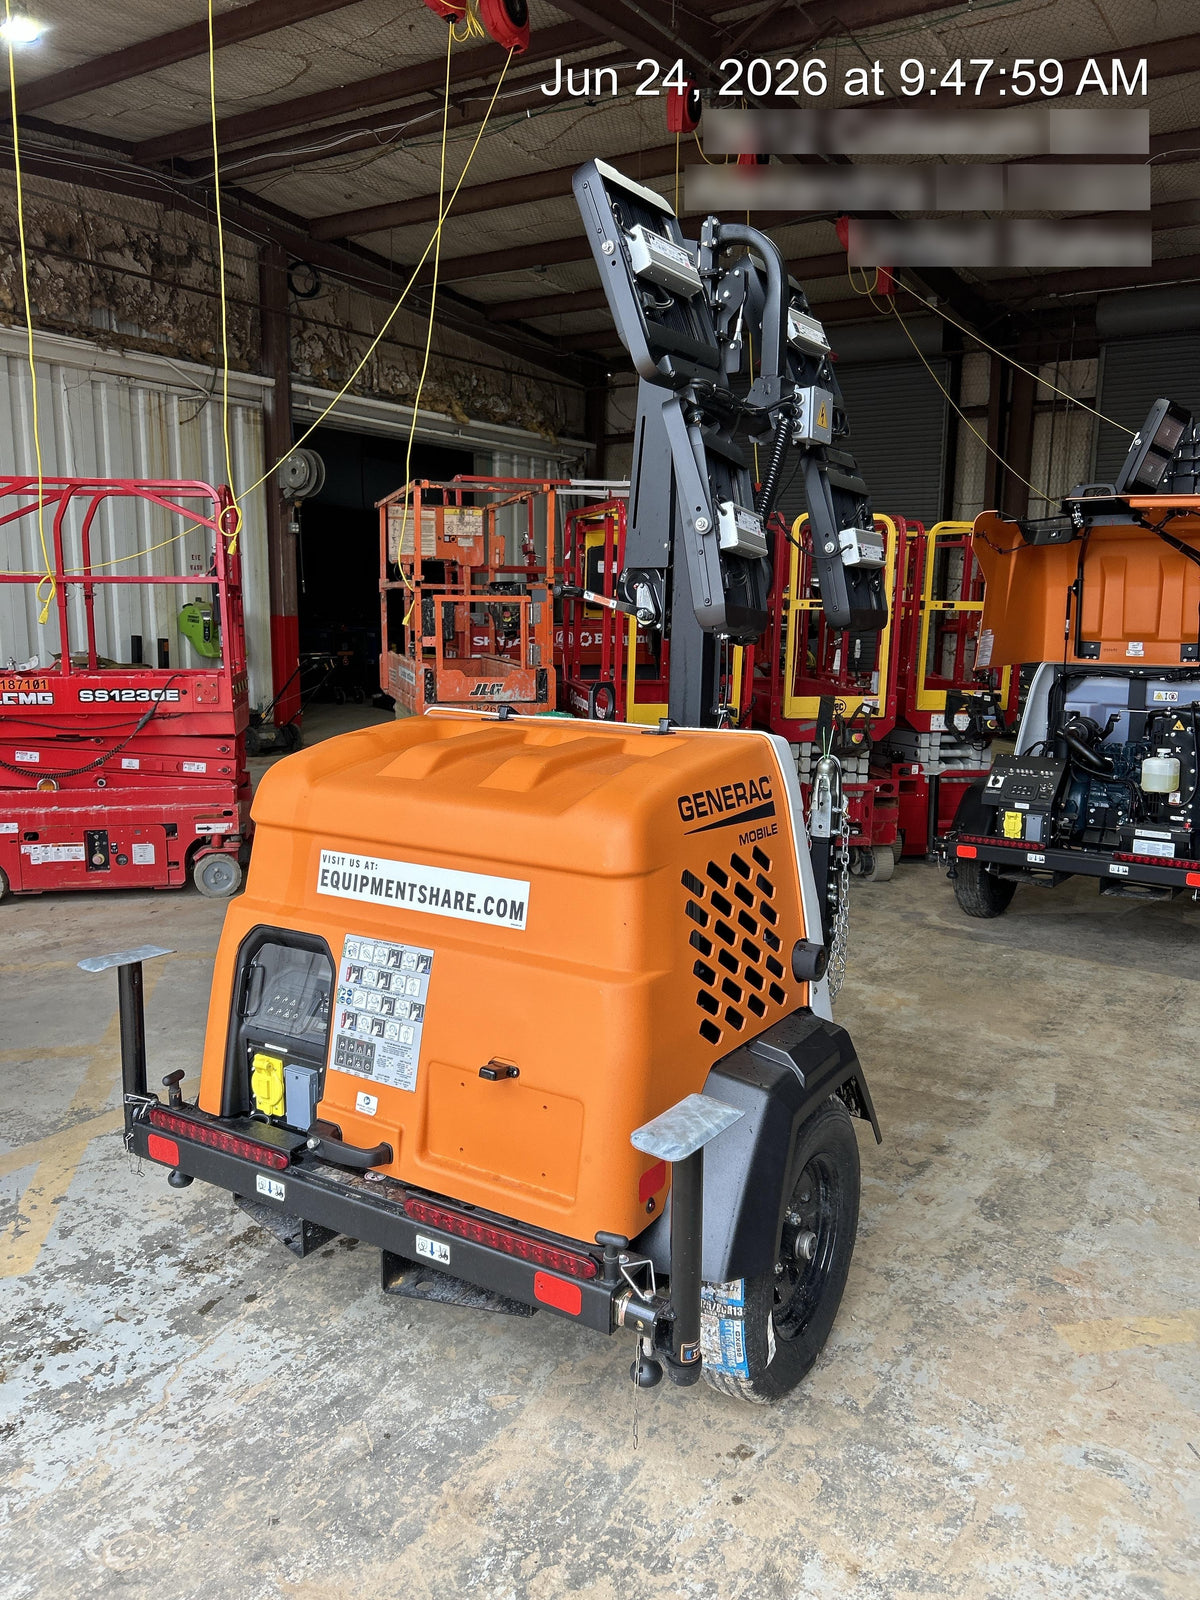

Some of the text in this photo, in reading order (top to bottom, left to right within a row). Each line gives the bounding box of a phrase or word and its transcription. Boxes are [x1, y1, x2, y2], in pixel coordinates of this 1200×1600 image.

[79, 689, 180, 703] SS1230E
[470, 682, 504, 696] JLG
[677, 775, 773, 822] GENERAC
[738, 823, 779, 846] MOBILE
[322, 853, 378, 871] VISIT US AT:
[320, 868, 525, 921] EQUIPMENTSHARE.COM
